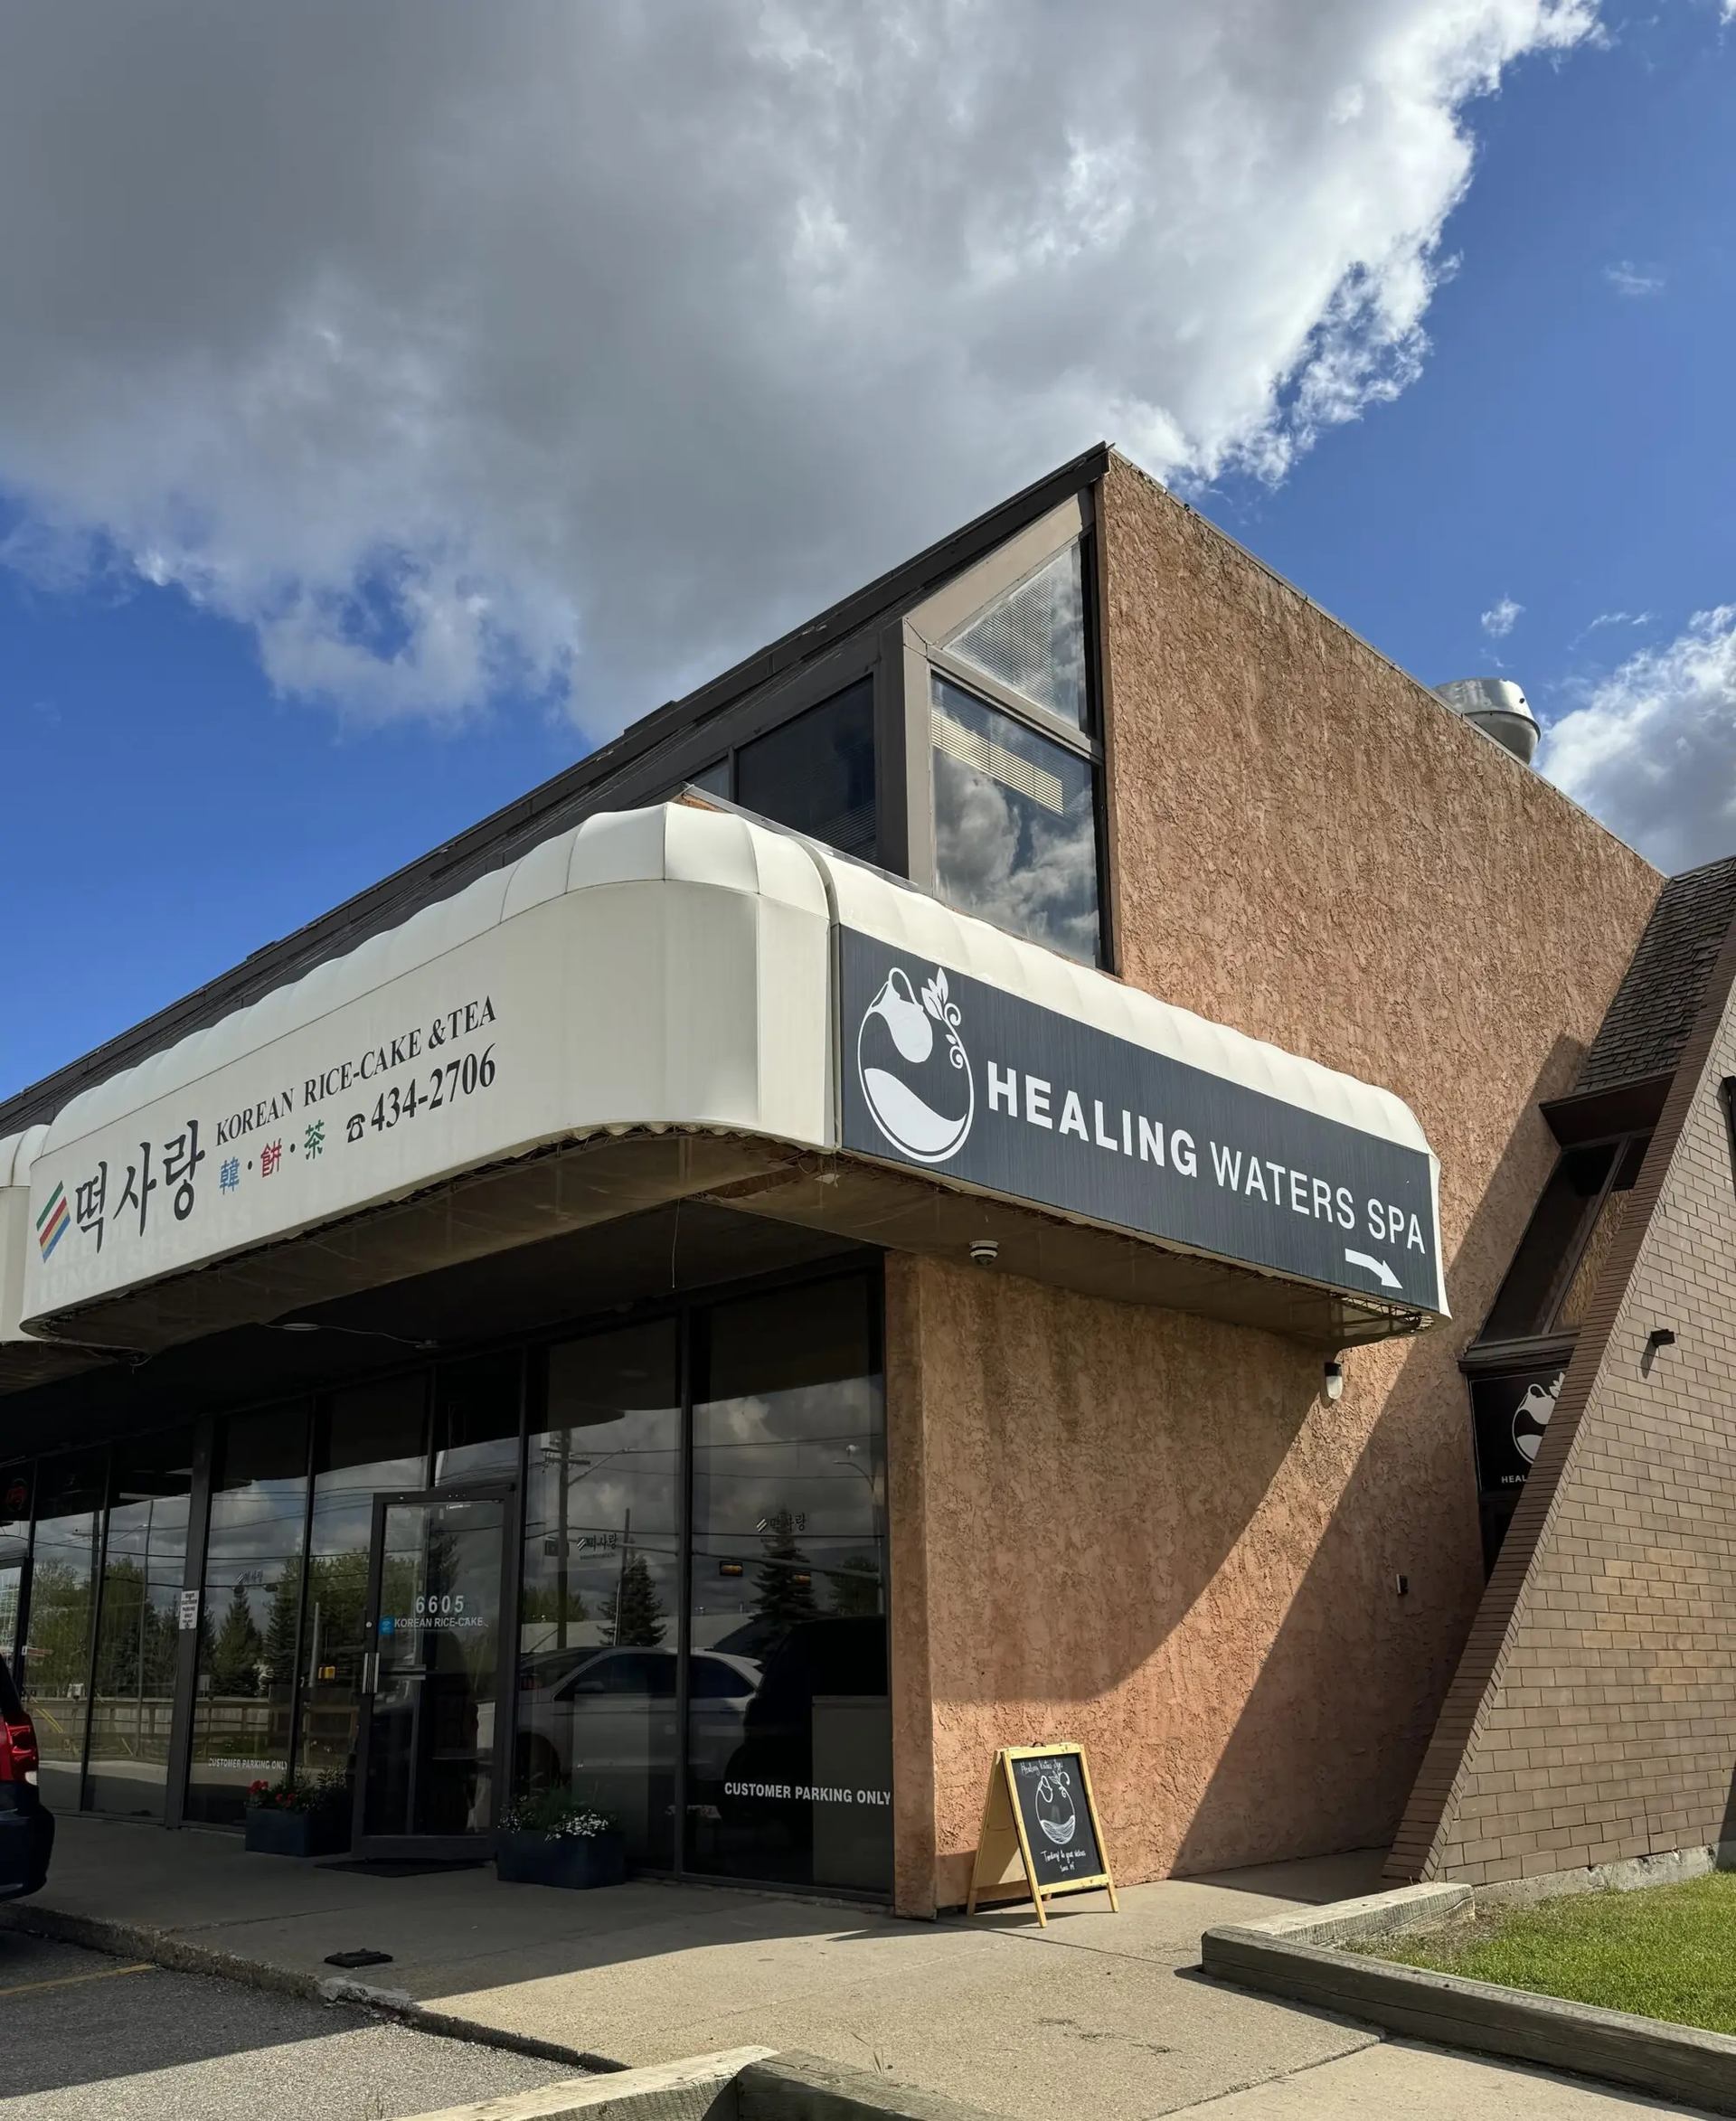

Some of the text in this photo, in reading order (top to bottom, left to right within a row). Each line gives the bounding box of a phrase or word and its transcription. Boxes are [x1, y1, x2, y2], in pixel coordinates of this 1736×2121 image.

[215, 1088, 294, 1145] KOREAN
[304, 1028, 421, 1107] RICE-CAKE
[371, 1042, 496, 1131] 434-2706
[986, 1060, 1426, 1255] HEALING WATERS SPA
[75, 1119, 205, 1253] 떡사랑
[394, 1617, 484, 1628] KOREAN RICE-CAKE
[416, 1595, 464, 1614] 6605
[208, 1757, 288, 1770] CUSTOMER PARKING ONLY
[724, 1782, 892, 1805] CUSTOMER PARKING ONLY
